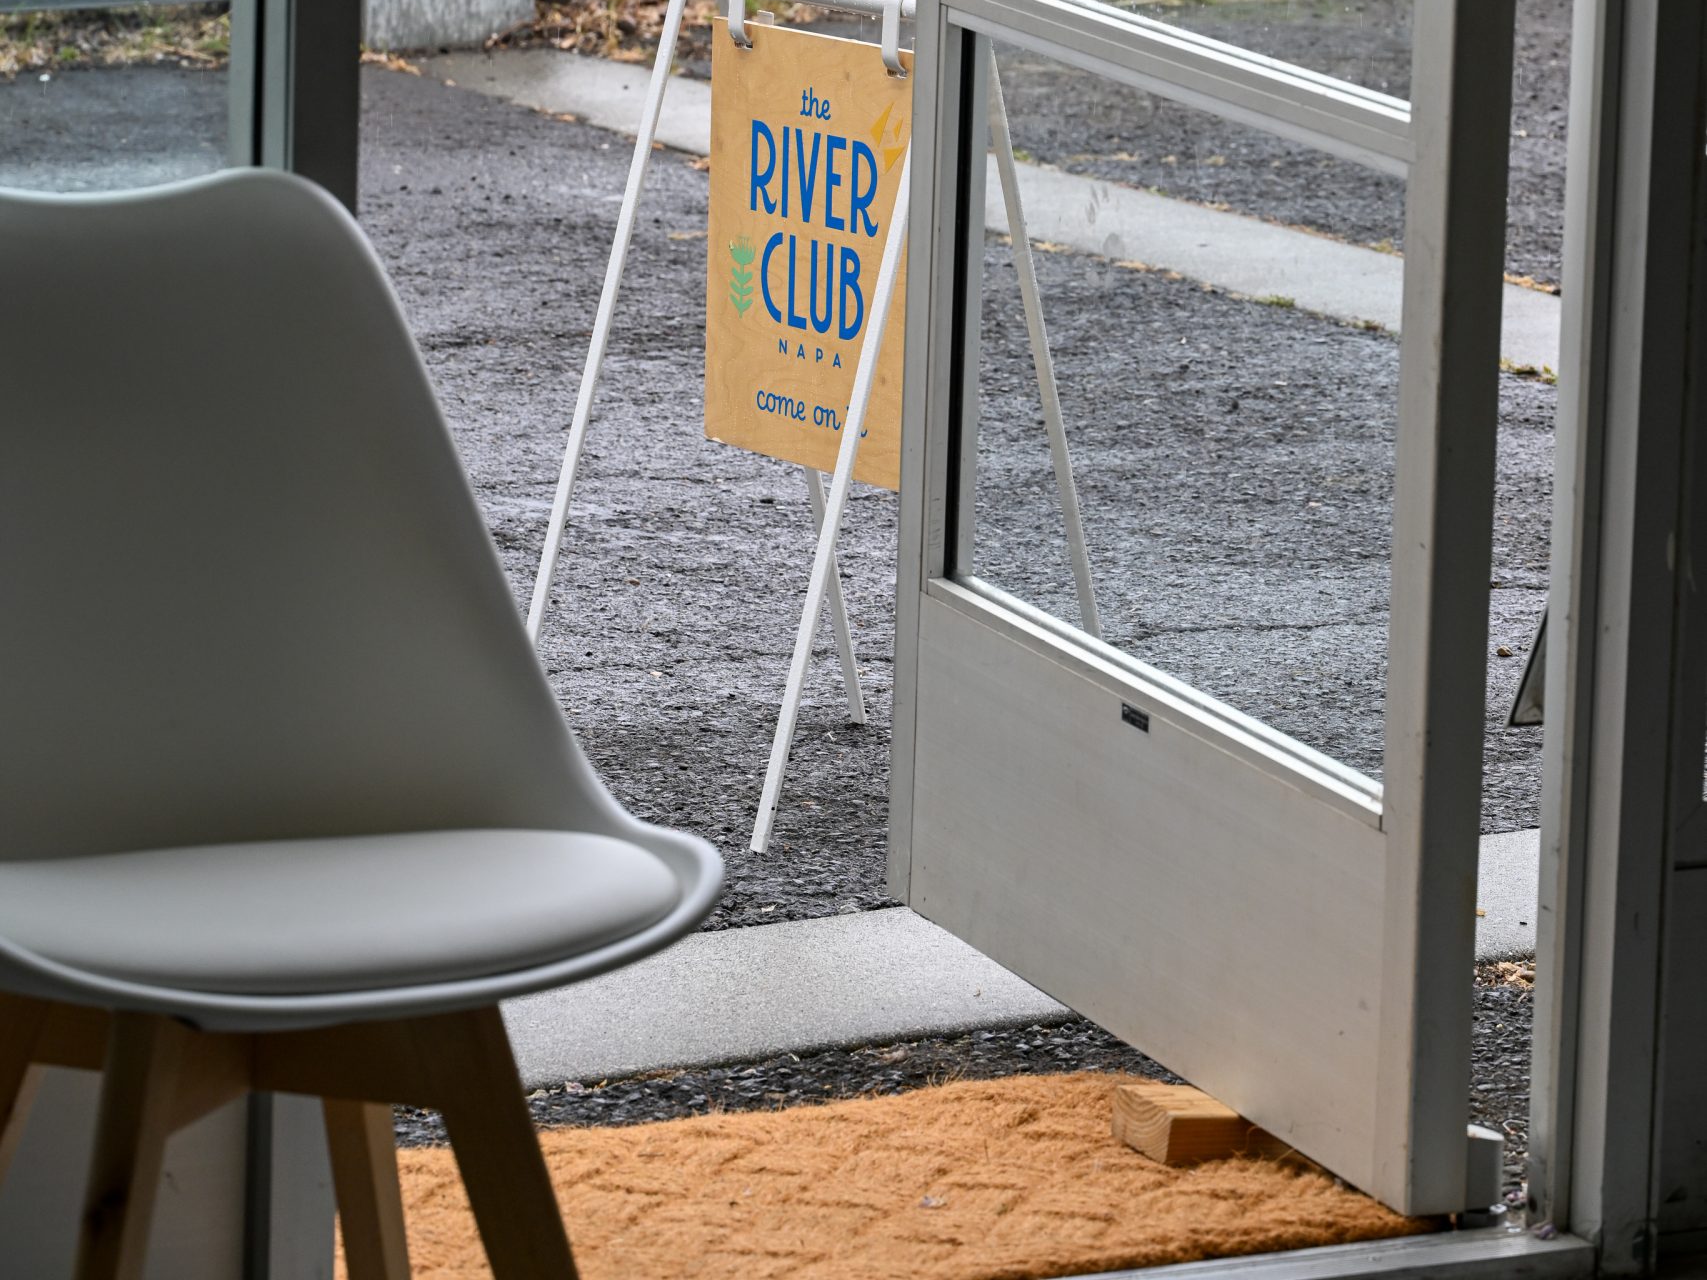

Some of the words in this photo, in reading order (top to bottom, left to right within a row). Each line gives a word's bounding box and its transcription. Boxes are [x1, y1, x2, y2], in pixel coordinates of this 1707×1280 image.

[800, 87, 831, 120] the
[750, 120, 879, 238] RIVER
[760, 231, 864, 340] CLUB
[779, 339, 842, 368] NAPA
[756, 390, 806, 421] come
[813, 405, 841, 431] on
